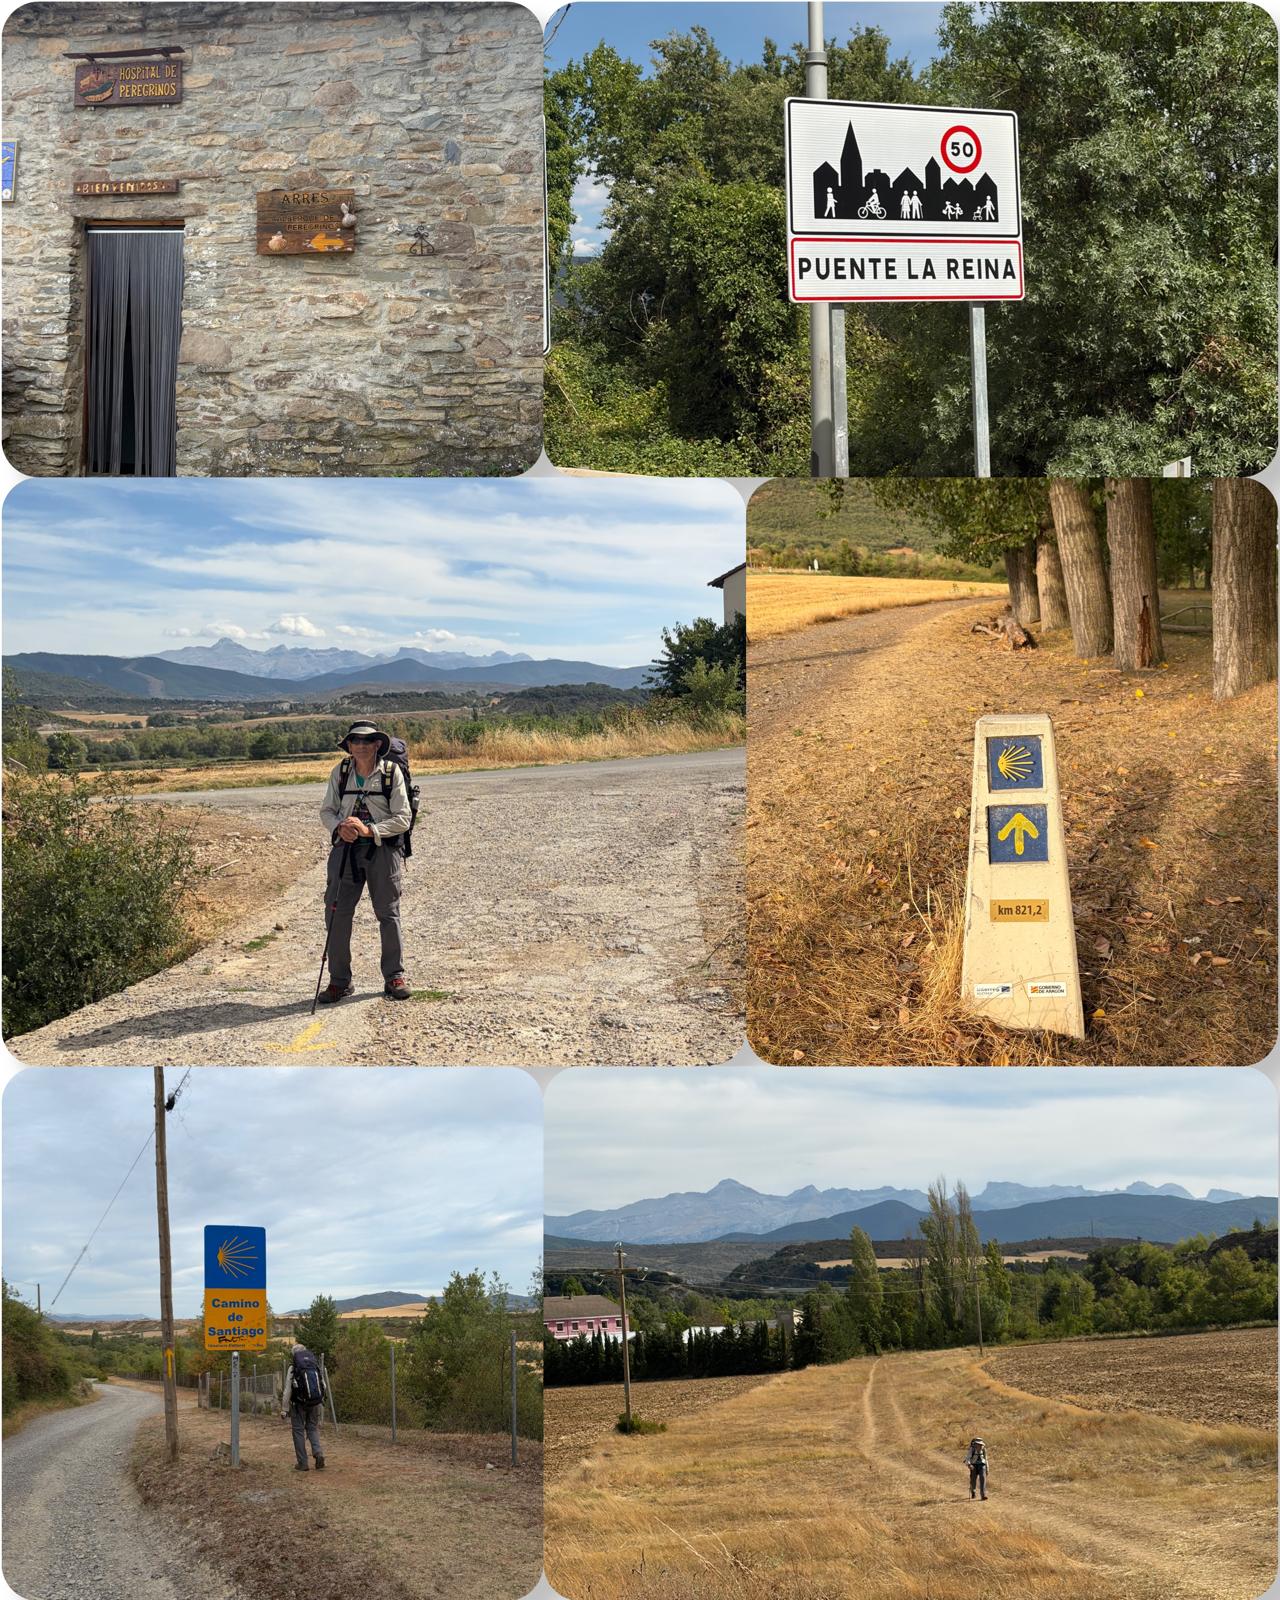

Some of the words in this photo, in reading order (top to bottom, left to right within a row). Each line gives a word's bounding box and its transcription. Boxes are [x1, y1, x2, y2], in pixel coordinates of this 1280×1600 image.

[165, 65, 177, 78] DE
[950, 141, 974, 158] 50
[281, 192, 329, 204] ARRES
[798, 257, 898, 280] PUENTE
[907, 257, 937, 280] LA
[946, 257, 1017, 280] REINA
[998, 905, 1013, 915] km
[1015, 905, 1042, 916] 821,2
[212, 1298, 260, 1308] Camino
[227, 1312, 243, 1321] de
[208, 1326, 264, 1337] Santiago
